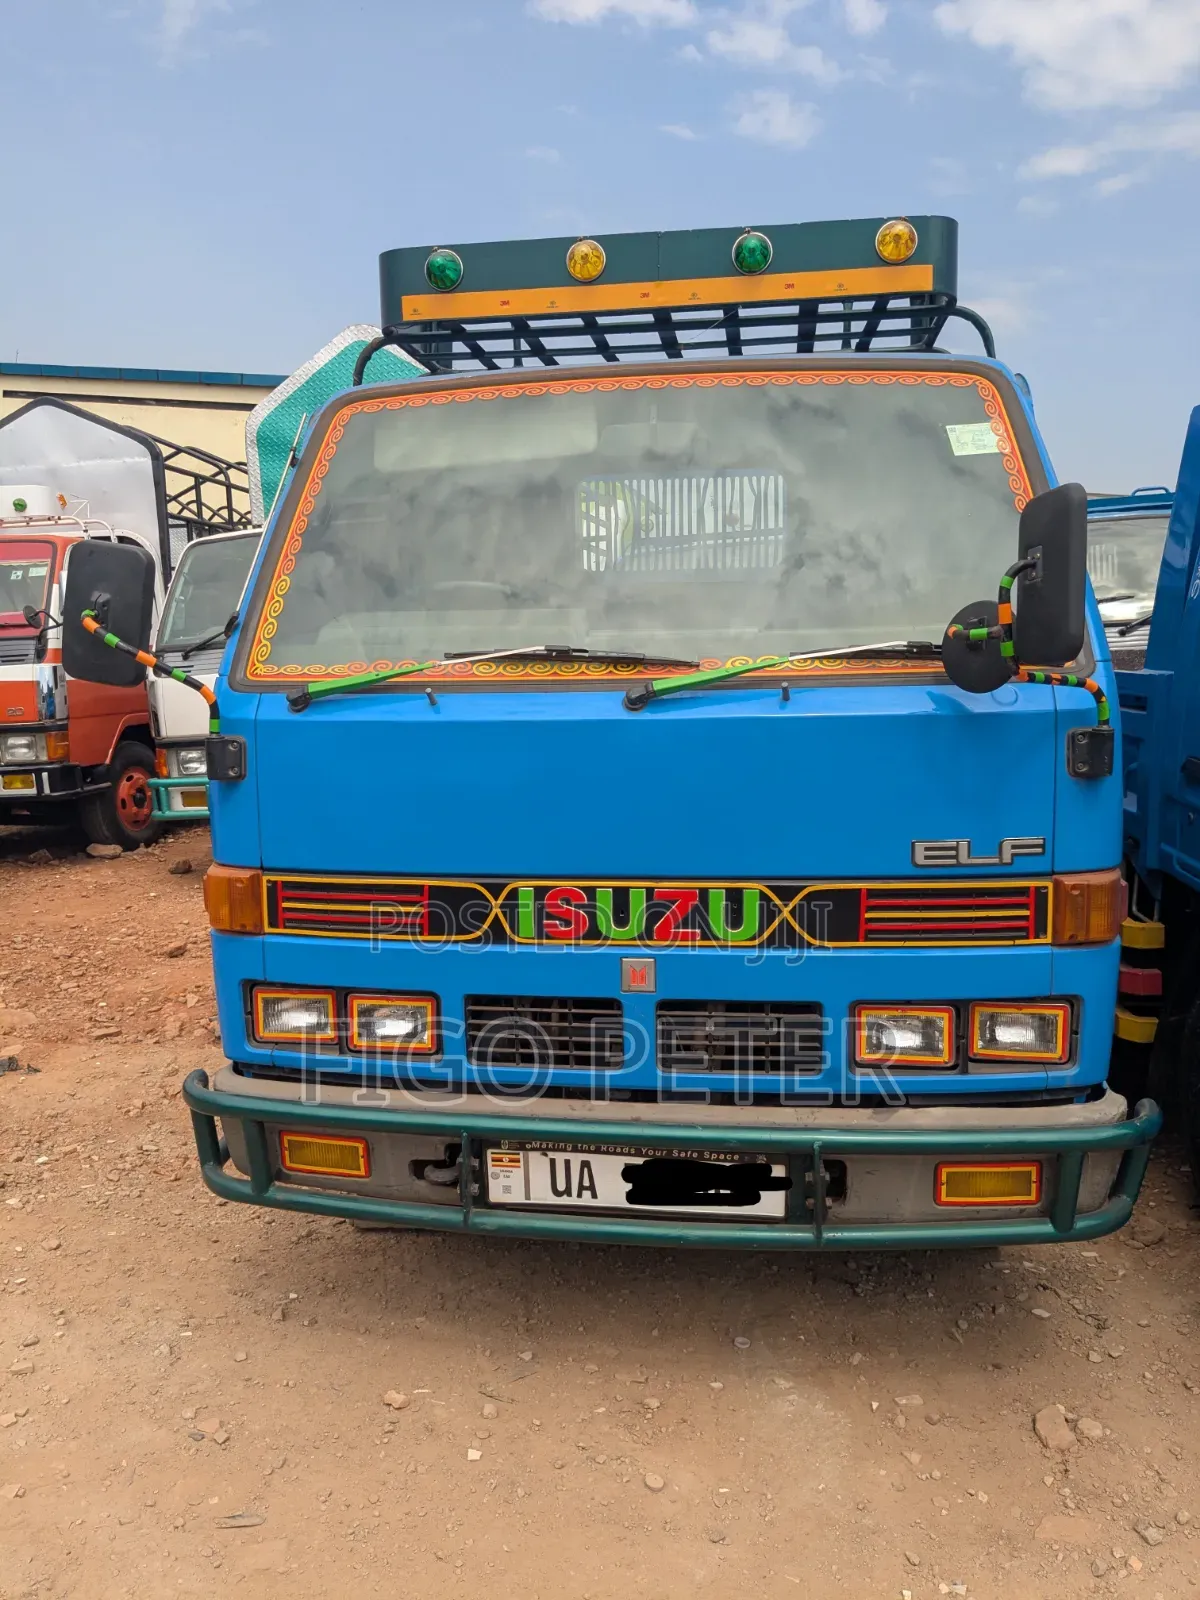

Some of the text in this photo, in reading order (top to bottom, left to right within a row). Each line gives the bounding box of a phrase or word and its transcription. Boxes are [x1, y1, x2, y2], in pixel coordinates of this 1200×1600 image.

[911, 836, 1046, 867] ELF
[518, 886, 760, 941] ISUZU
[531, 1141, 573, 1151] Making
[601, 1144, 636, 1154] Roads
[641, 1147, 667, 1156] Your
[672, 1149, 698, 1158] Safe
[703, 1152, 739, 1161] Space
[549, 1157, 598, 1199] UA
